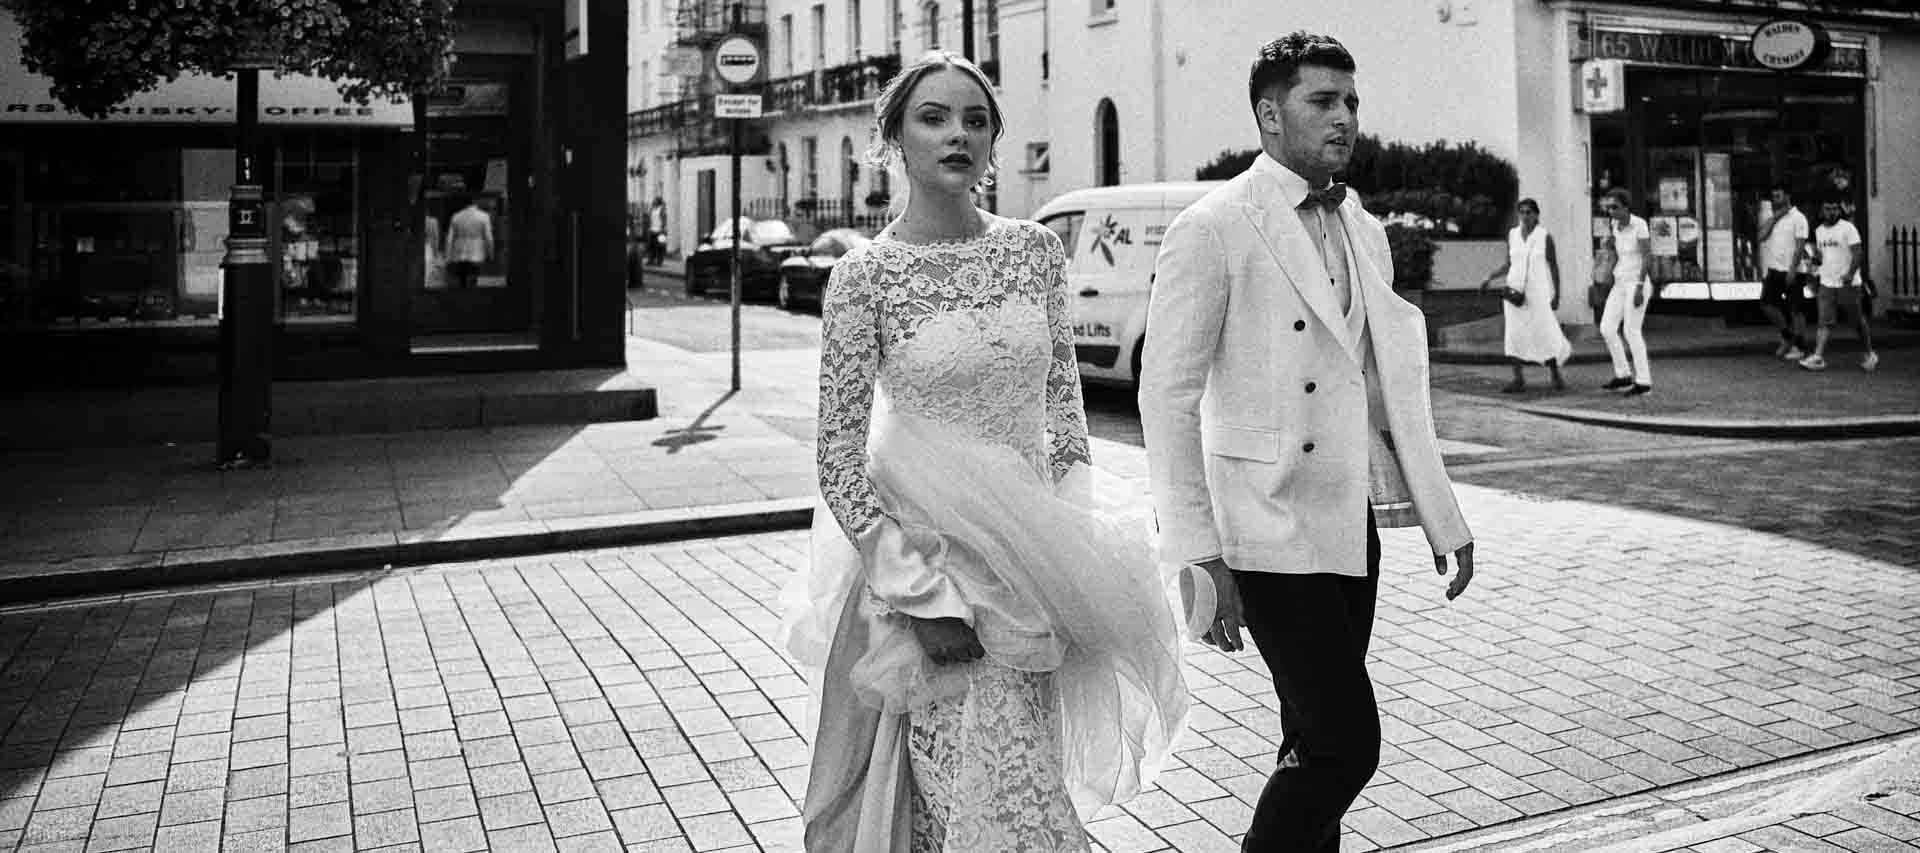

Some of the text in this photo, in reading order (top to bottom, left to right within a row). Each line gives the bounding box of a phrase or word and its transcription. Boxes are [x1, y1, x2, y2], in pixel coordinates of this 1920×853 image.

[1764, 23, 1801, 38] WALDEN
[1601, 33, 1630, 58] 65
[109, 107, 222, 115] HISKY
[265, 107, 374, 116] OFFEE
[1112, 227, 1133, 245] AL
[1087, 322, 1111, 338] Lifts
